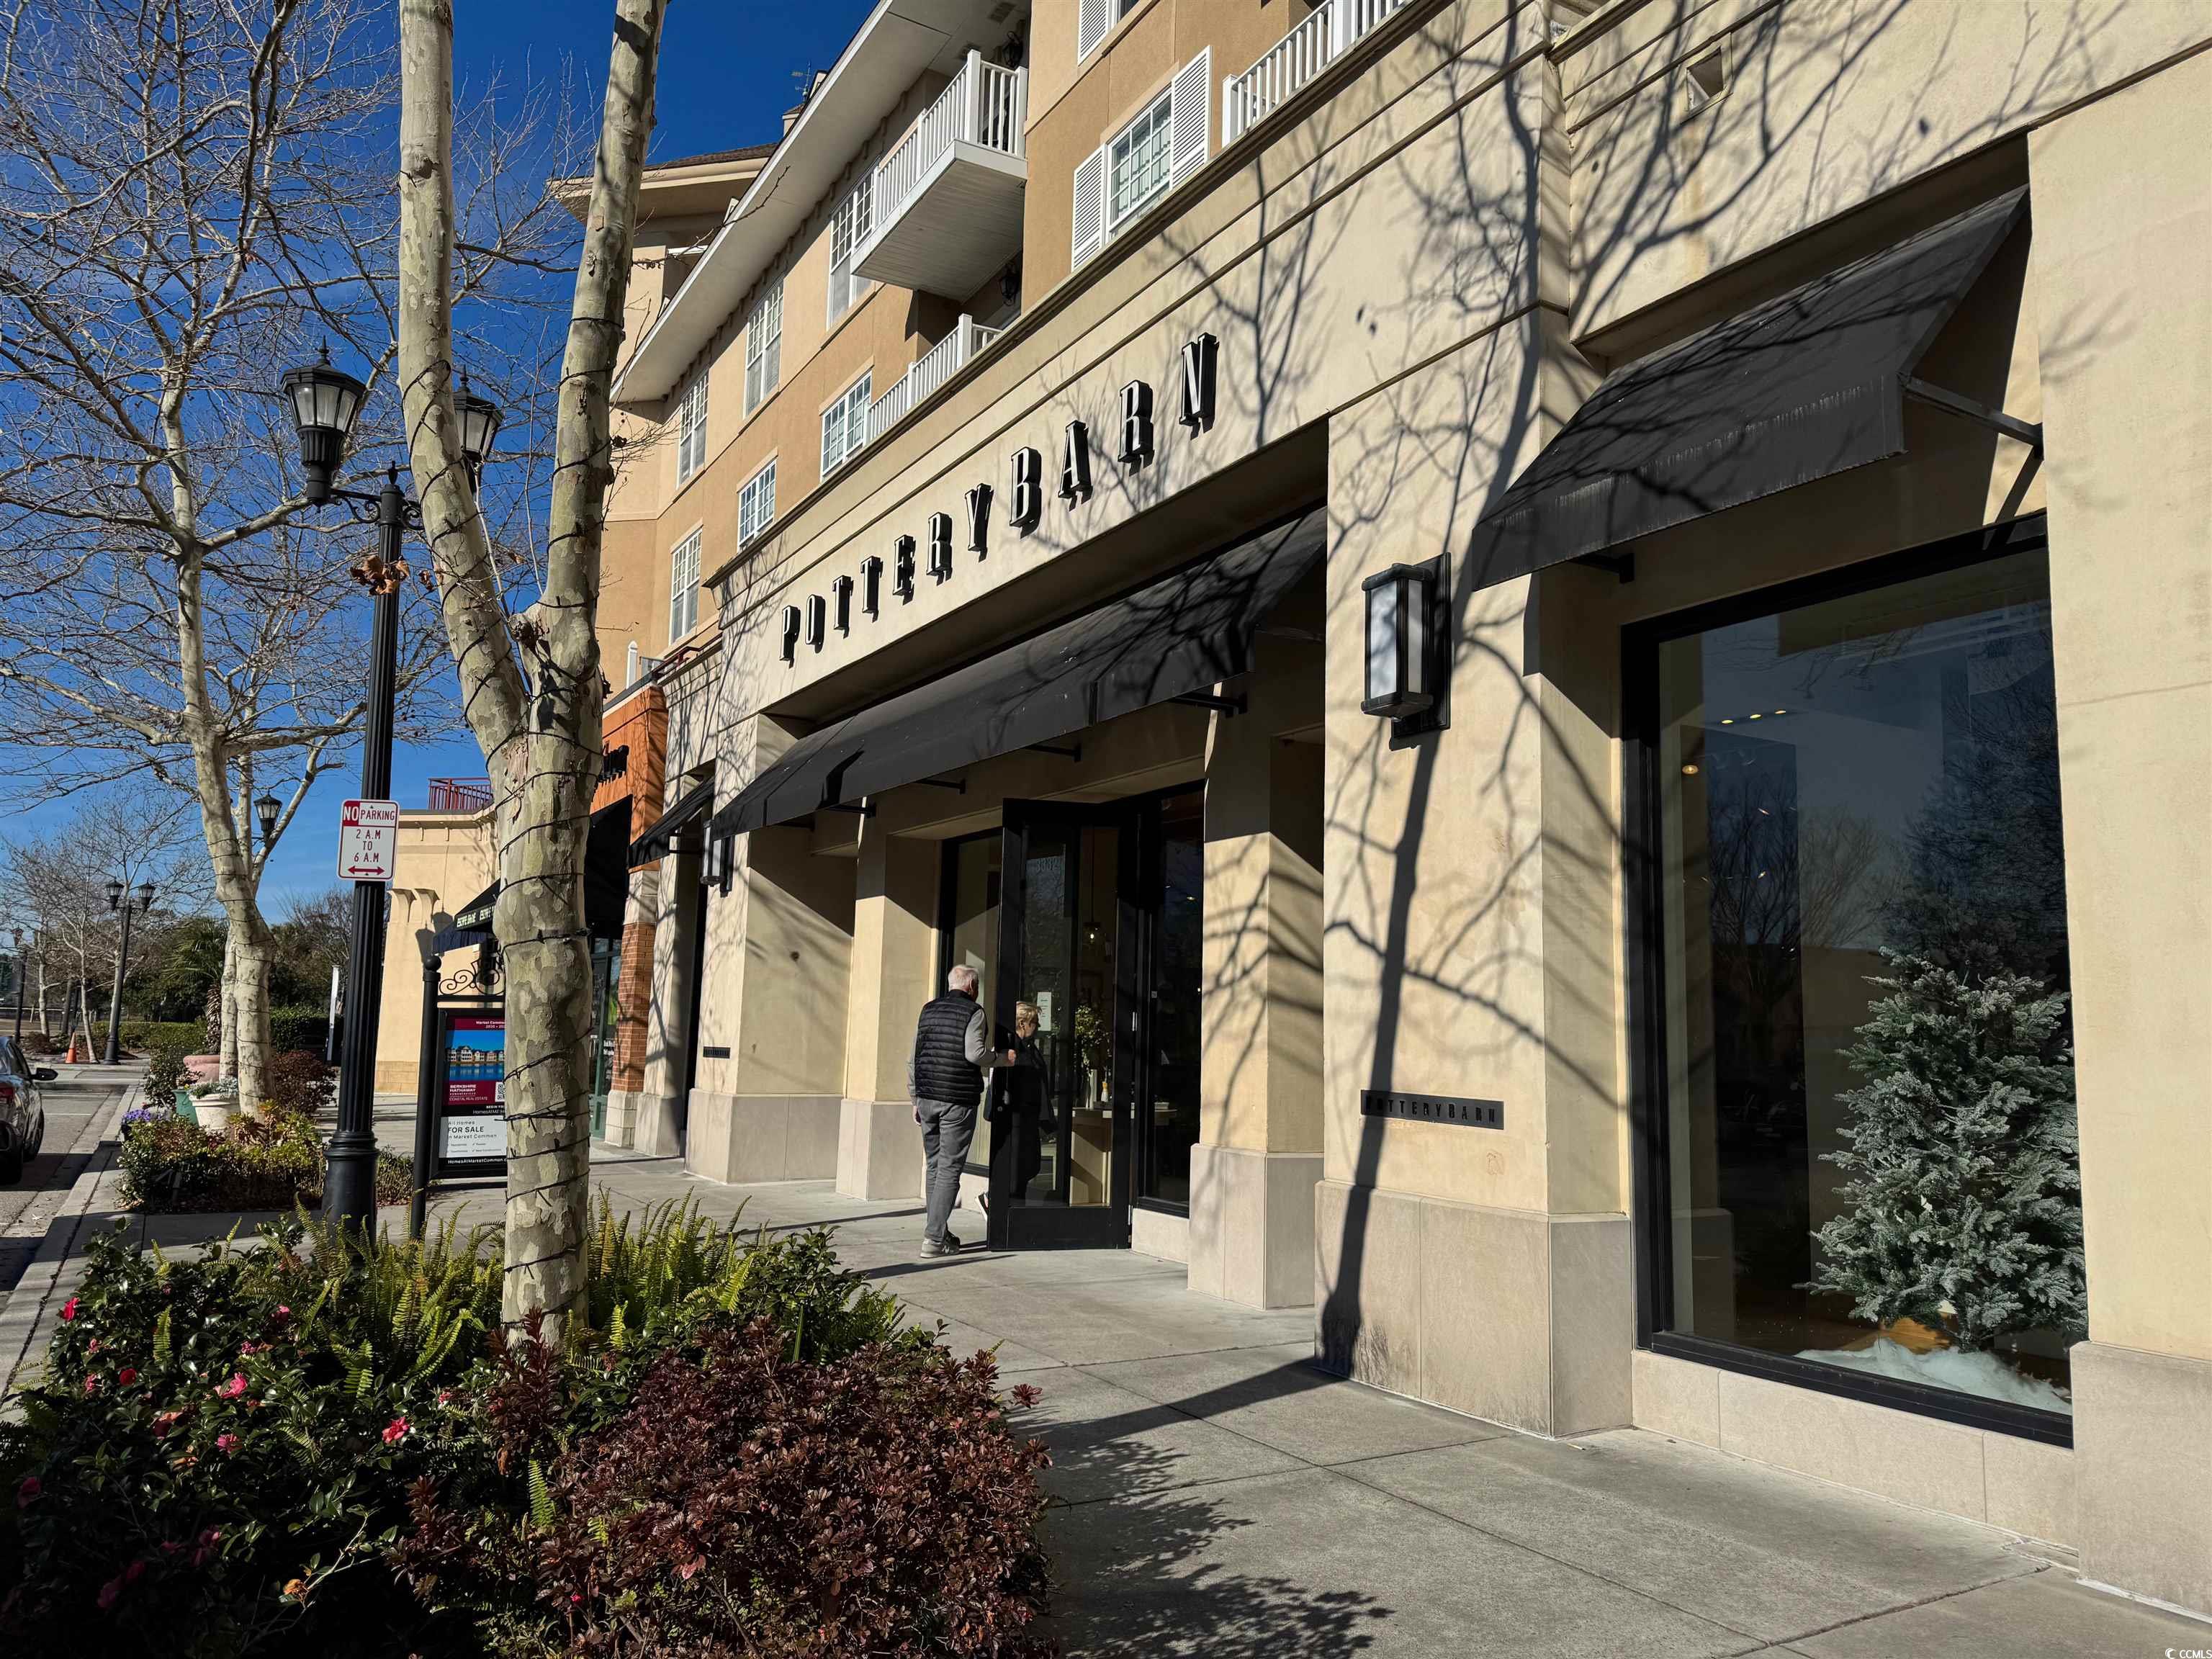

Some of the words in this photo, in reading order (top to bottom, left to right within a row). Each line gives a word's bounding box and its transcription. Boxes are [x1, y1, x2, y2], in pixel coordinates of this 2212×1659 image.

[343, 806, 359, 821] NO
[360, 809, 395, 821] PARKING
[356, 829, 361, 839] 2
[365, 830, 381, 840] A.M
[363, 840, 373, 850] TO
[354, 852, 359, 863] 6
[364, 853, 379, 863] A.M
